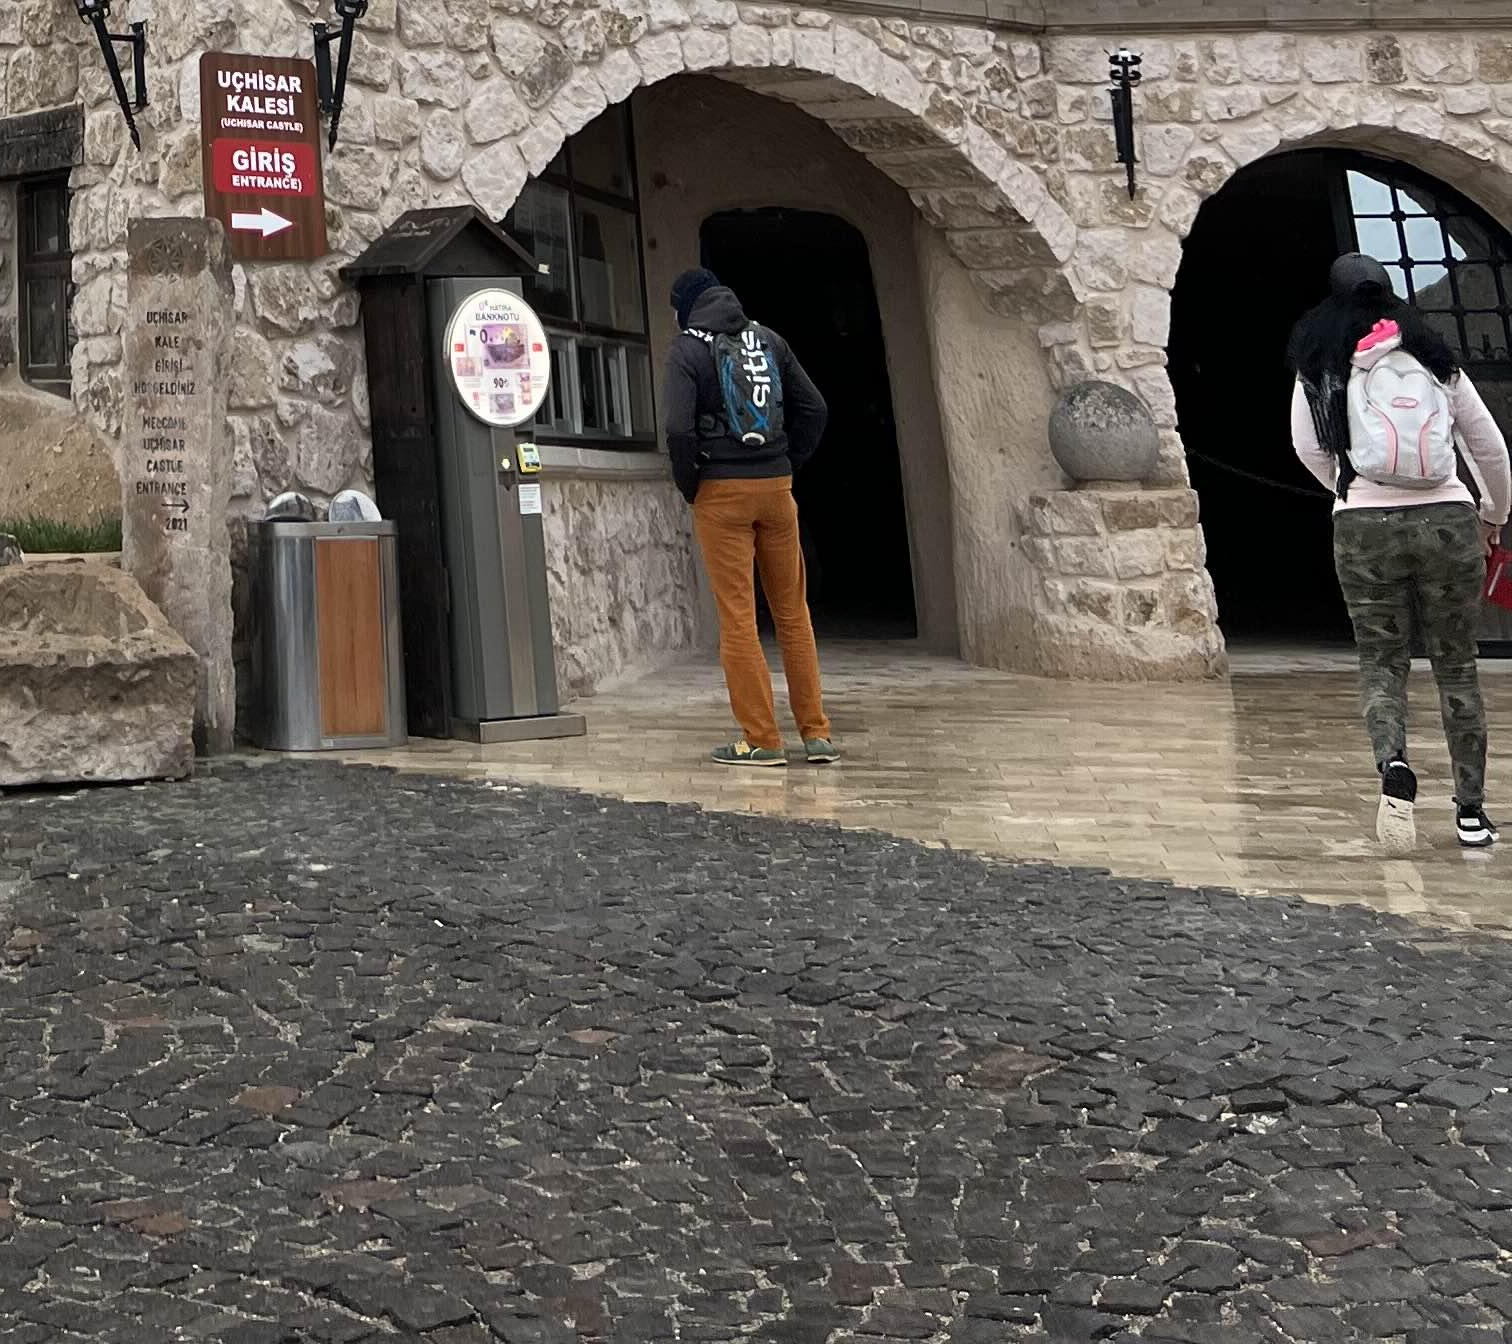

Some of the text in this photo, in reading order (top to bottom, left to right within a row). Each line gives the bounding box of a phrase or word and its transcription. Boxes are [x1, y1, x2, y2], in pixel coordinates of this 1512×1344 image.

[217, 69, 303, 93] UÇHİSAR
[226, 94, 295, 116] KALESİ
[266, 120, 304, 134] CASTLE)
[232, 145, 296, 178] GİRİŞ
[231, 174, 302, 192] ENTRANCE)
[154, 335, 180, 349] KALE
[142, 415, 186, 431] WELCOME
[146, 459, 183, 473] CASTLE
[136, 481, 186, 496] ENTRANCE
[165, 517, 188, 530] 2021
